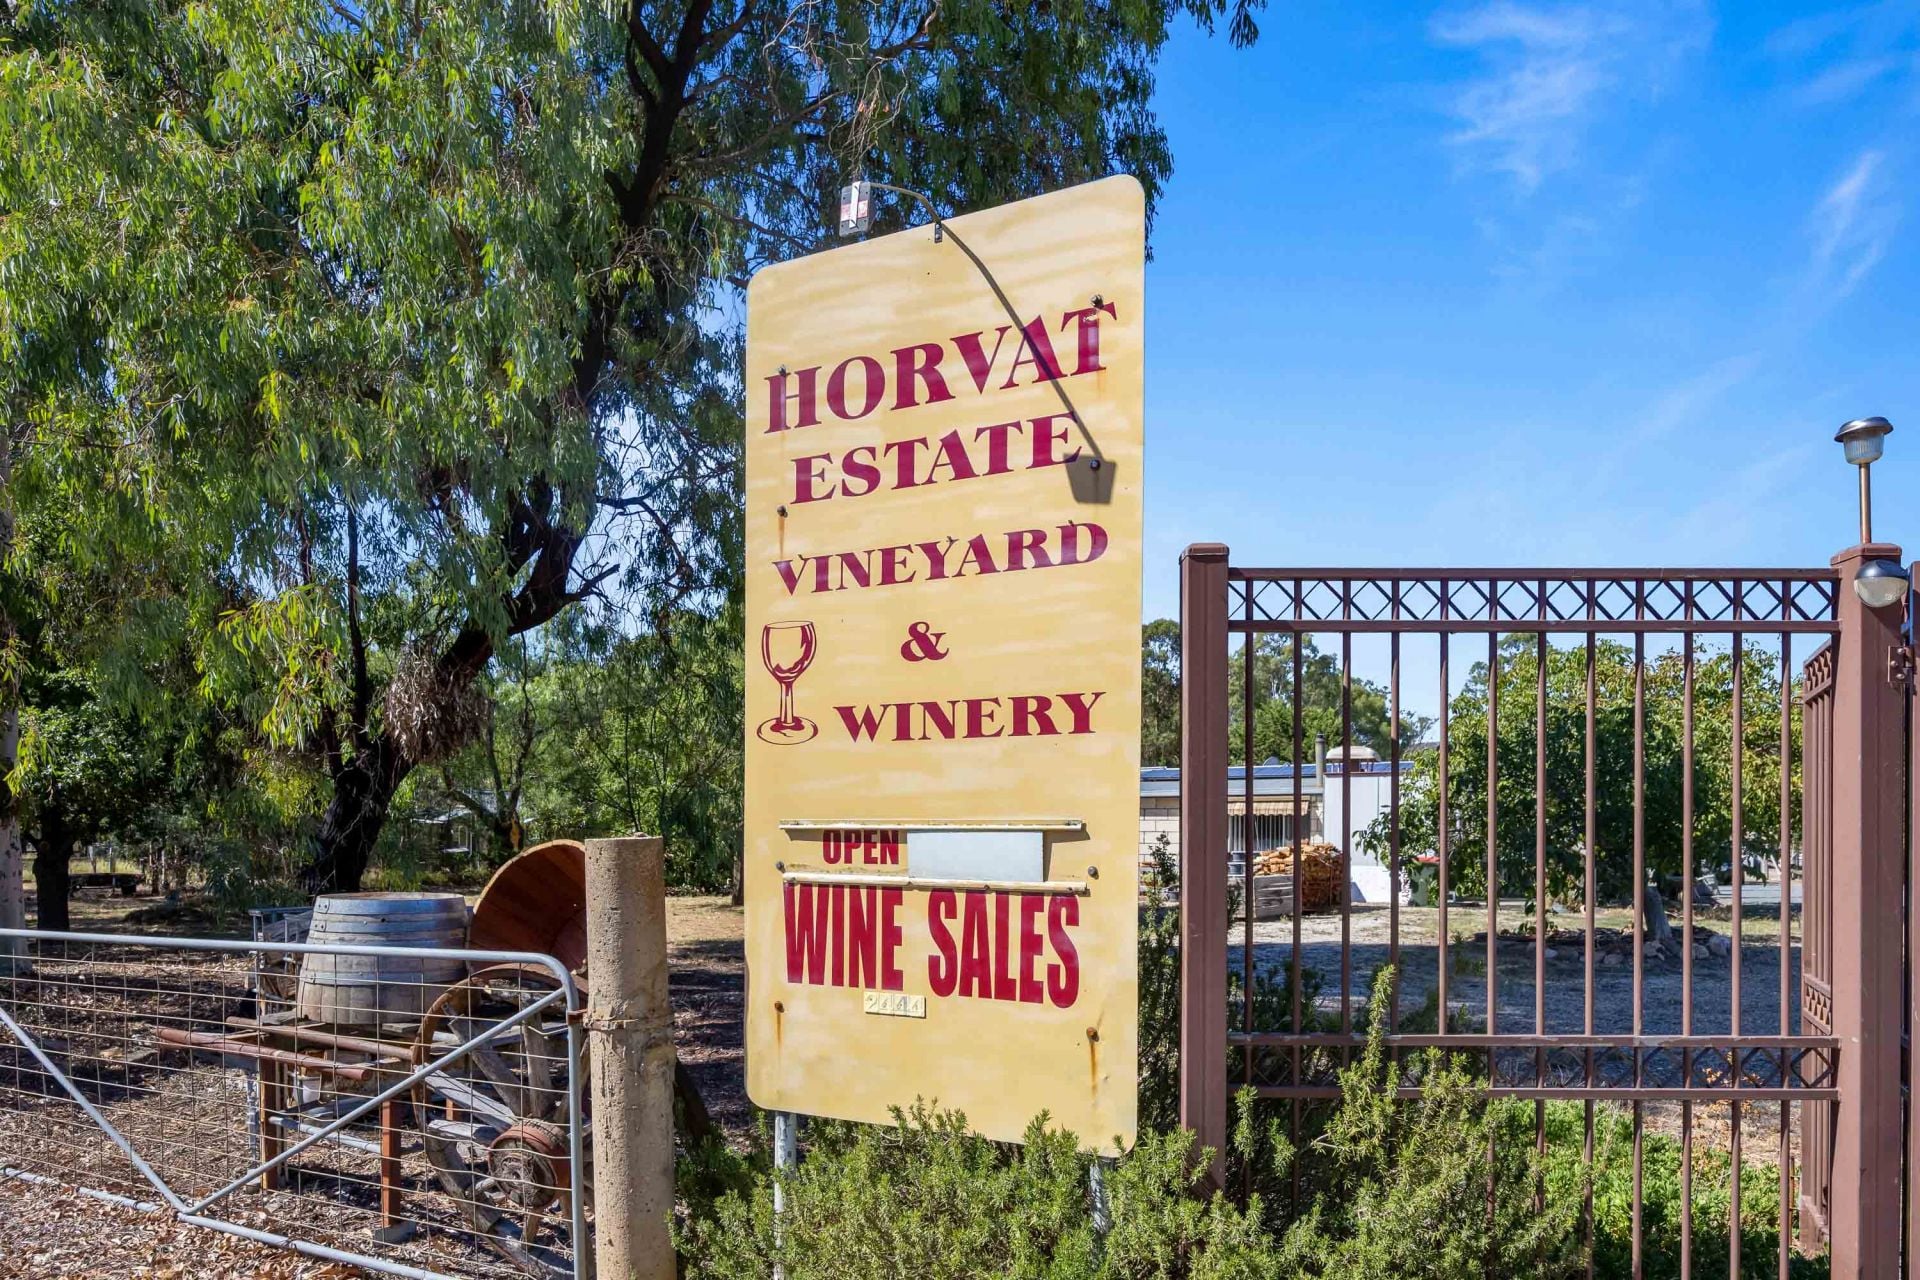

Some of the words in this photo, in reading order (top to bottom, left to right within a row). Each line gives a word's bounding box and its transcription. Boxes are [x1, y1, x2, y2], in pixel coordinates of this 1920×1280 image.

[764, 302, 1118, 433] HORVAT
[790, 411, 1082, 504] ESTATE
[773, 522, 1108, 596] VINEYARD
[900, 621, 949, 662] &
[833, 692, 1106, 742] WINERY
[823, 829, 899, 864] OPEN
[784, 883, 903, 991] WINE
[927, 888, 1080, 1009] SALES
